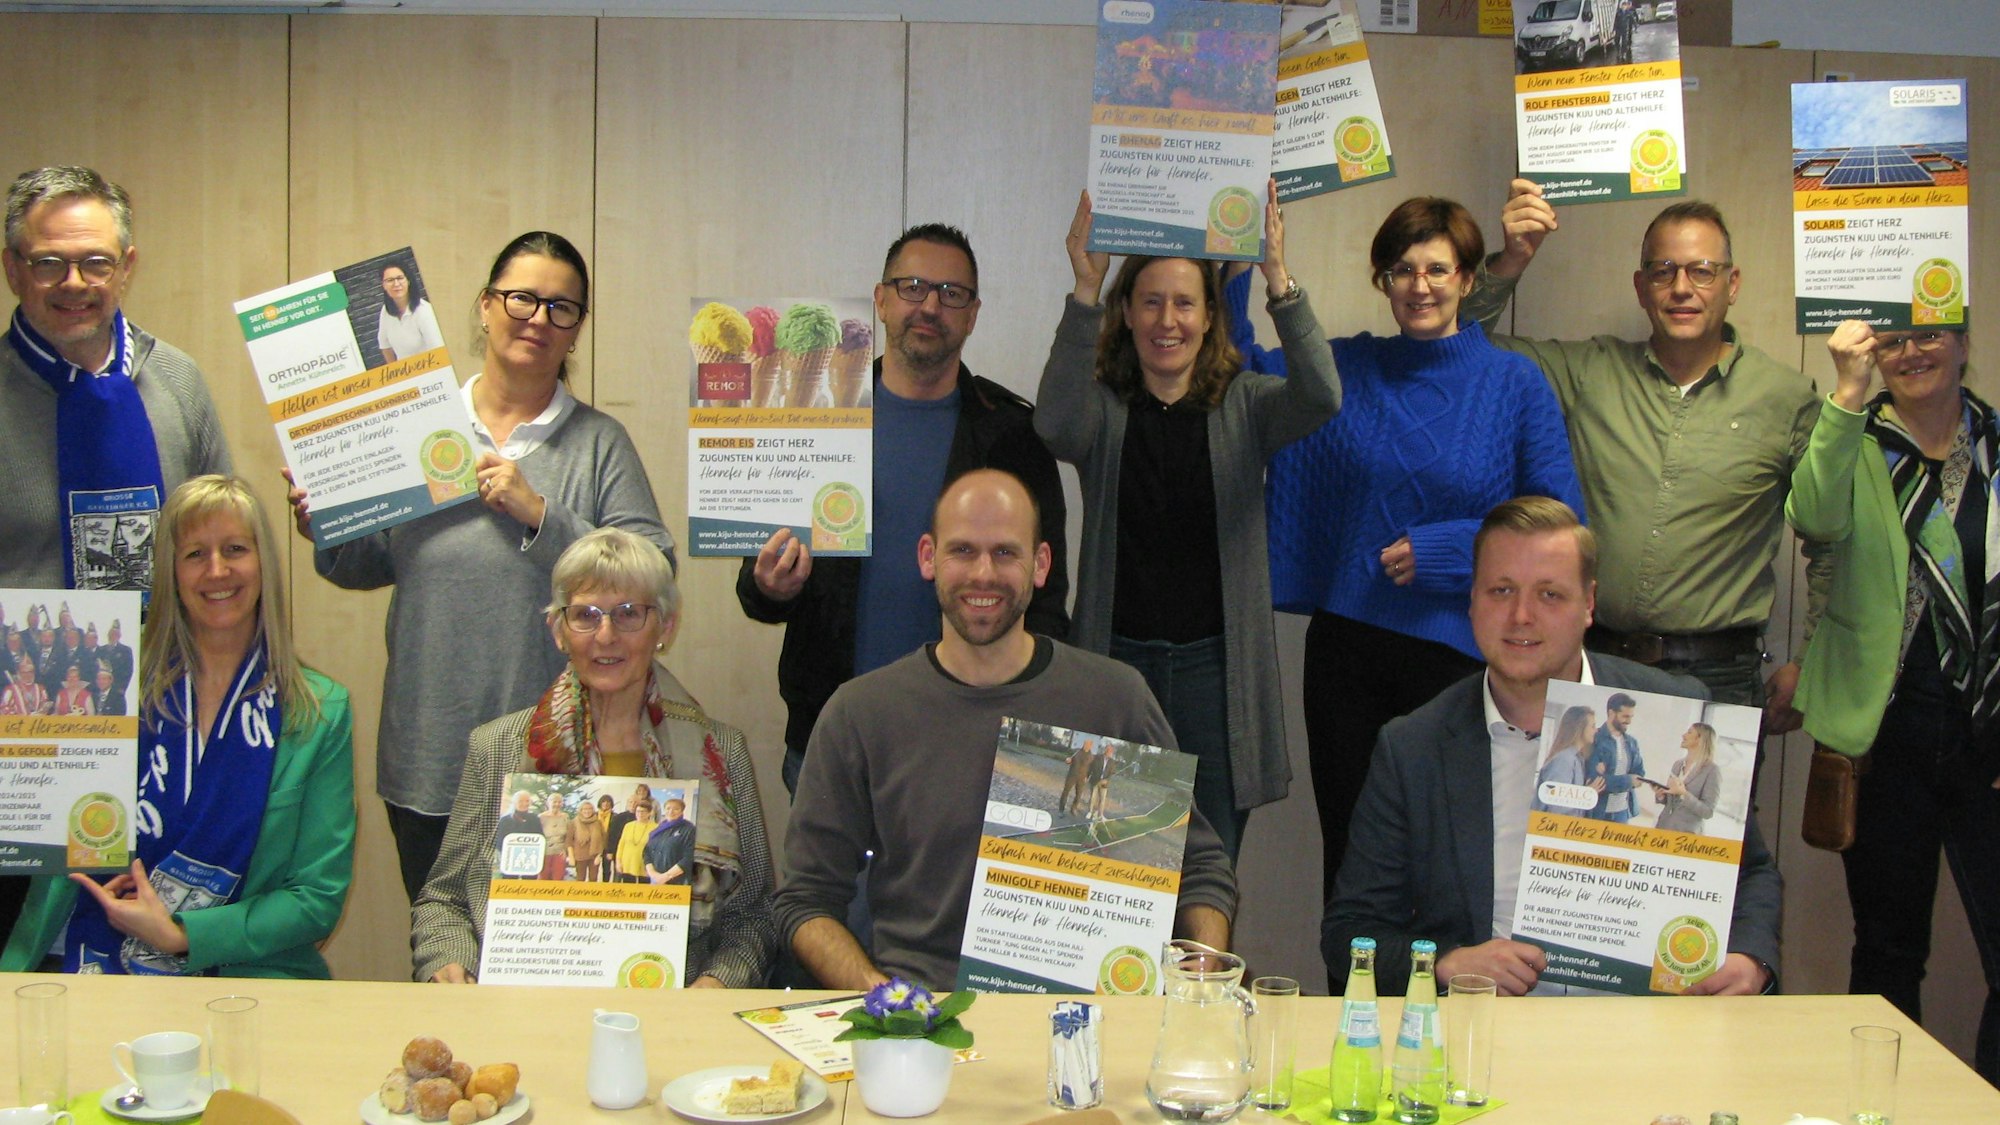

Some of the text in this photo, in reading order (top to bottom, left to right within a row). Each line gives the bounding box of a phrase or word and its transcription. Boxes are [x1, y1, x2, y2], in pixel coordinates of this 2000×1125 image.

[1300, 77, 1352, 96] ZEIGT HERZ
[1525, 90, 1664, 109] ROLF FENSTERBAU ZEIGT HERZ
[1893, 88, 1935, 99] SOLARIS
[1291, 100, 1309, 111] UND
[1526, 108, 1612, 122] ZUGUNSTEN UND
[1101, 135, 1117, 145] DIE
[1163, 138, 1191, 148] ZEIGT
[1194, 140, 1220, 150] HERZ
[1099, 150, 1254, 167] ZUGUNSTEN UND ALTENHILFE:
[1804, 218, 1901, 229] SOLARIS ZEIGT HERZ
[1804, 234, 1855, 243] ZUGUNSTEN
[1877, 233, 1895, 241] UND
[1898, 231, 1952, 240] ALTENHILFE:
[268, 350, 347, 383] ORTHOPÄDIE
[421, 381, 443, 394] ZEIGT
[706, 381, 744, 390] REMOR
[293, 438, 313, 450] HERZ
[316, 422, 361, 442] ZUGUNSTEN
[383, 410, 398, 420] UND
[699, 438, 814, 448] REMOR EIS ZEIGT HERZ
[776, 454, 795, 462] UND
[798, 454, 855, 462] ALTENHILFE:
[16, 747, 57, 756] GEFOLGE
[60, 747, 92, 755] ZEIGEN
[95, 747, 118, 756] HERZ
[20, 760, 38, 769] UND
[1531, 848, 1695, 881] FALC IMMOBILIEN ZEIGT HERZ
[1529, 865, 1595, 884] ZUGUNSTEN
[1624, 879, 1649, 892] UND
[1651, 883, 1722, 902] ALTENHILFE:
[985, 871, 1153, 910] MINIGOLF HENNEF ZEIGT HERZ
[584, 910, 646, 918] KLEIDERSTUBE
[983, 888, 1042, 907] ZUGUNSTEN
[1068, 904, 1090, 916] UND
[1092, 908, 1155, 927] ALTENHILFE:
[517, 920, 569, 928] ZUGUNSTEN
[612, 923, 668, 931] ALTENHILFE:
[968, 972, 1047, 994] www.kiju-hennef.de
